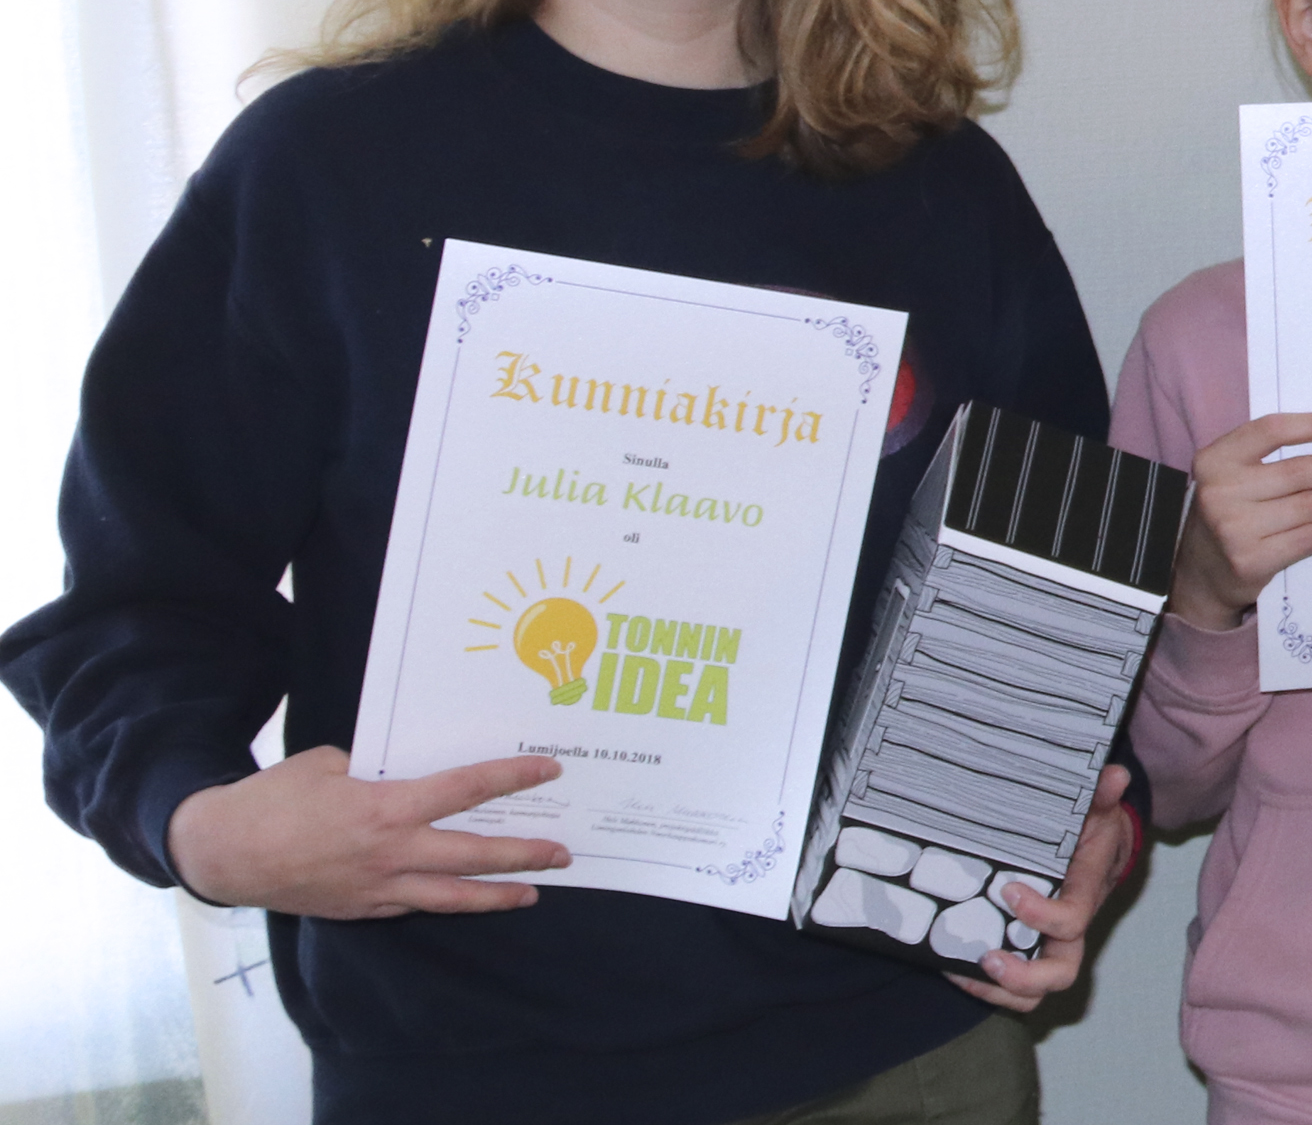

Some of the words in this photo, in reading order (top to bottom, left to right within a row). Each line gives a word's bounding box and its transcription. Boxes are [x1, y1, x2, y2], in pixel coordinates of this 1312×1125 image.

[491, 350, 824, 447] Kunniakirja
[622, 453, 669, 470] Sinulla
[503, 466, 609, 507] Julia
[622, 481, 765, 528] Klaavo
[622, 532, 640, 544] oli
[606, 612, 743, 664] TONNIN
[592, 652, 729, 726] IDEA
[517, 741, 589, 758] Lumijoella
[593, 747, 662, 765] 10.10.2018
